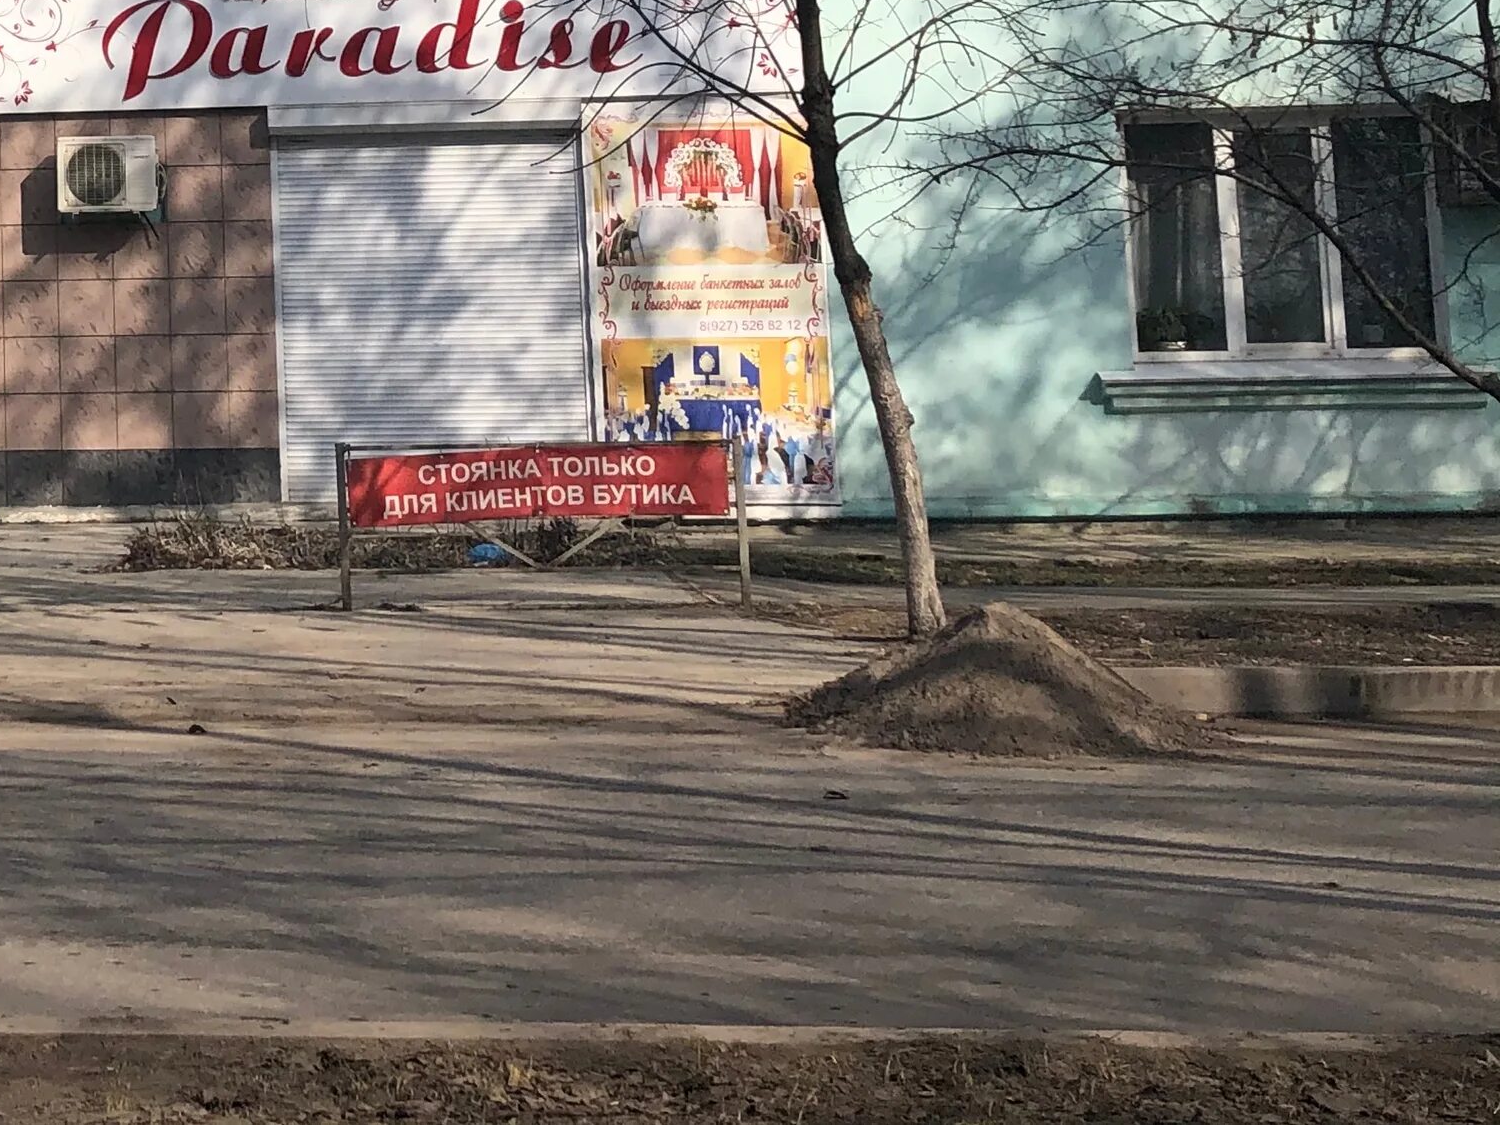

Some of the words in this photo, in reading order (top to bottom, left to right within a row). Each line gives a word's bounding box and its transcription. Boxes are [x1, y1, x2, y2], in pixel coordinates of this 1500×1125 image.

[619, 273, 697, 296] Оформление
[700, 274, 765, 290] банкетных
[768, 272, 801, 290] залов
[631, 300, 640, 311] и
[643, 294, 701, 312] выездных
[706, 296, 790, 315] регистраций
[742, 320, 764, 331] 526
[788, 319, 802, 331] 12
[417, 458, 541, 486] СТОЯНКА
[551, 455, 657, 478] ТОЛЬКО
[383, 492, 438, 520] ДЛЯ
[445, 484, 585, 513] КЛИЕНТОВ
[593, 483, 697, 506] БУТИКА
